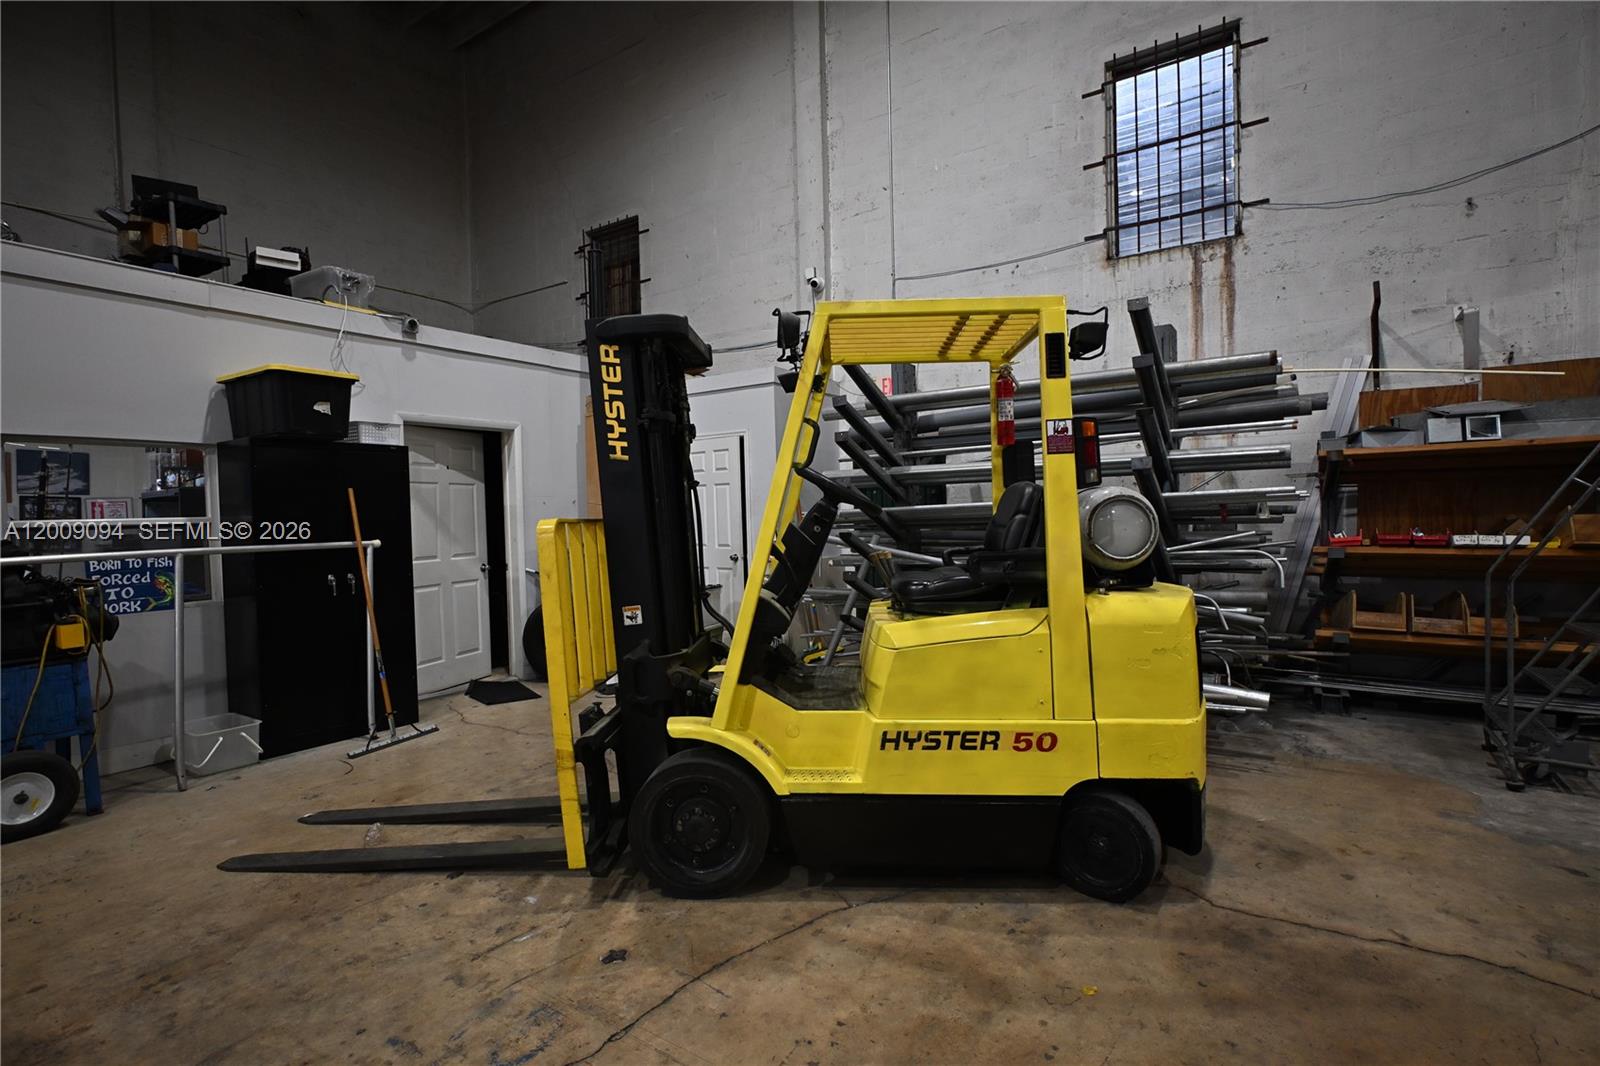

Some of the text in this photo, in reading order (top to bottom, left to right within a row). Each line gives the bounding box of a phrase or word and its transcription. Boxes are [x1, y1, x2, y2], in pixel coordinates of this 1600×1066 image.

[599, 344, 629, 461] HYSTER
[125, 558, 142, 568] TO
[105, 587, 134, 600] TO
[104, 602, 141, 613] ORK
[880, 731, 1058, 752] HYSTER 50
